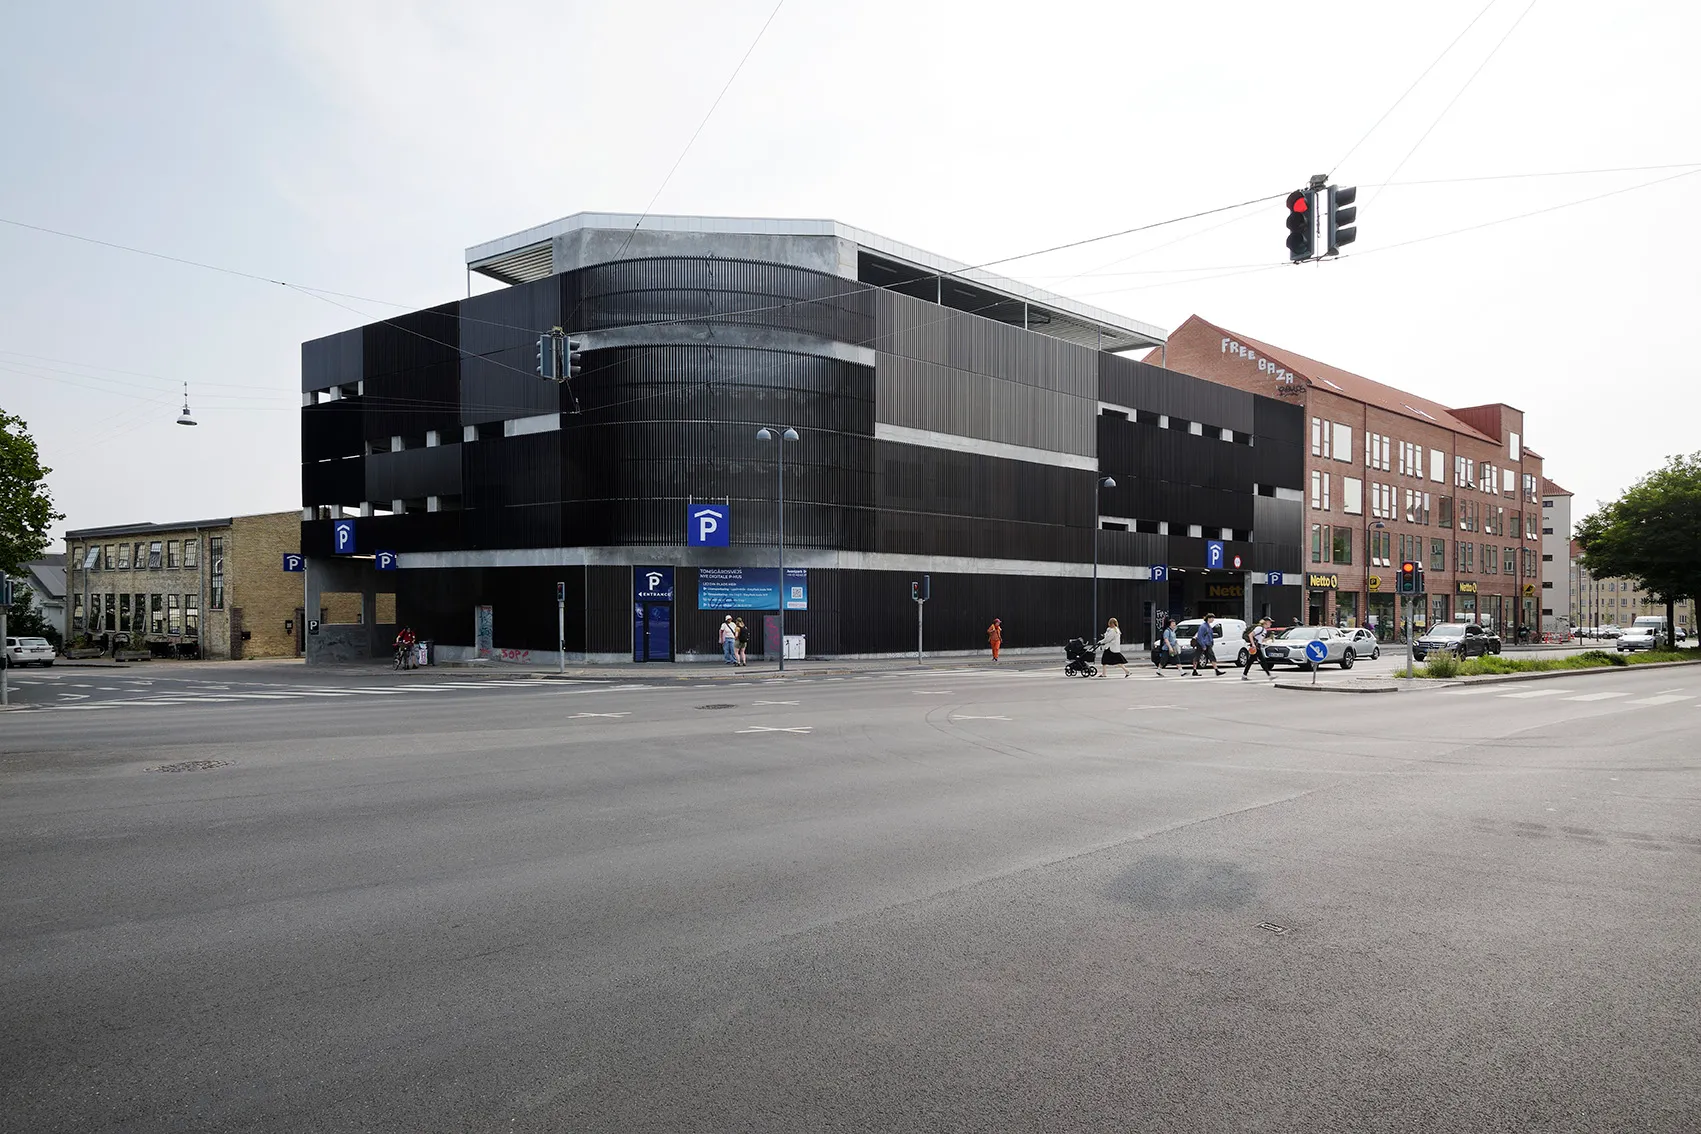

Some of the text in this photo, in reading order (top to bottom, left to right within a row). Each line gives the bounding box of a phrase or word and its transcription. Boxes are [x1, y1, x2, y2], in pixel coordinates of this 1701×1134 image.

[1221, 337, 1294, 385] FREE GAZA
[700, 516, 718, 542] P
[339, 530, 348, 550] P
[381, 555, 391, 569] P
[1212, 549, 1220, 566] P
[289, 558, 299, 571] P
[1155, 569, 1163, 580] P
[1271, 574, 1279, 585] P
[1310, 574, 1331, 587] Netto
[649, 576, 661, 591] P
[1459, 582, 1474, 592] Netto
[310, 620, 318, 630] P
